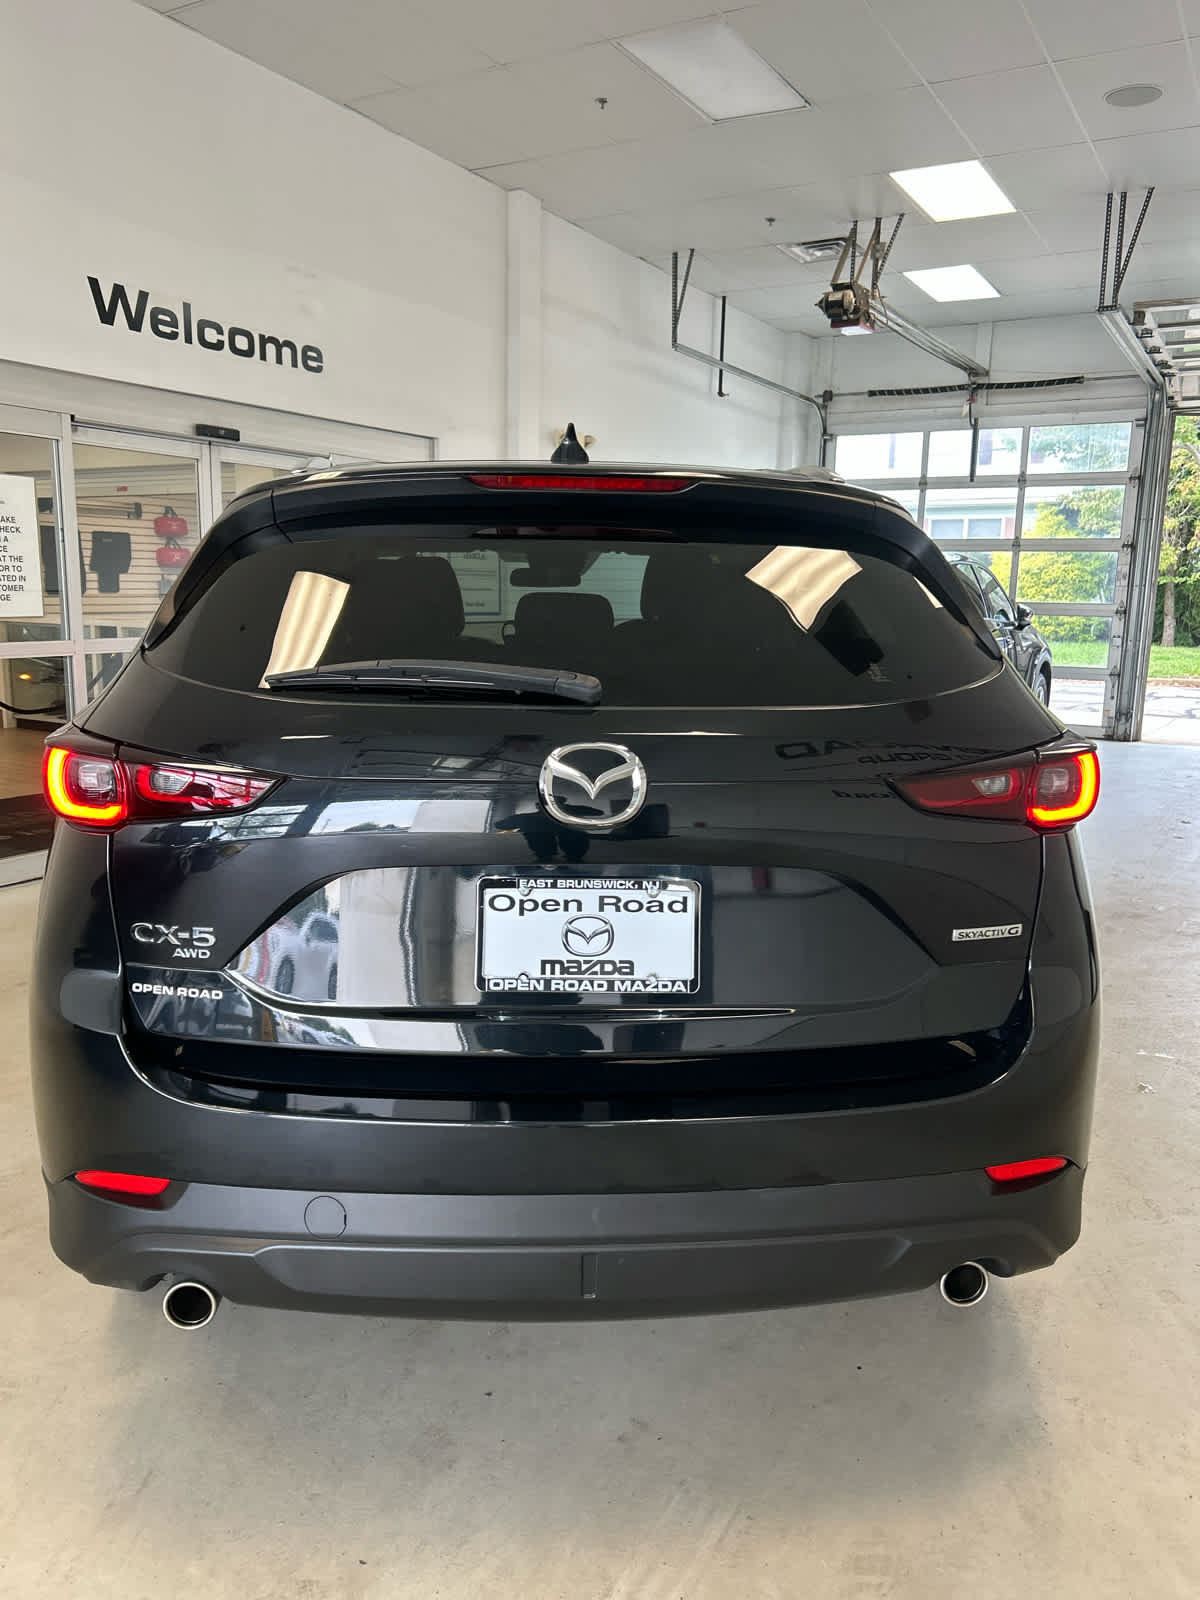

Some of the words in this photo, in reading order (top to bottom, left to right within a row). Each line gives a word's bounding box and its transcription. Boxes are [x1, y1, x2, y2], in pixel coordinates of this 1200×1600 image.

[87, 275, 323, 373] Welcome
[8, 555, 24, 563] THE
[12, 565, 22, 573] TO
[0, 584, 24, 592] OMER
[519, 879, 553, 888] EAST
[557, 879, 638, 889] BRUNSWICK,
[642, 880, 660, 889] NJ
[488, 894, 583, 916] Open
[598, 895, 688, 913] Road
[130, 922, 216, 947] CX-5
[172, 948, 211, 959] AWD
[132, 982, 174, 995] OPEN
[177, 986, 223, 1000] ROAD
[489, 978, 544, 992] OPEN
[551, 979, 608, 992] ROAD
[614, 979, 686, 992] MAZDA
